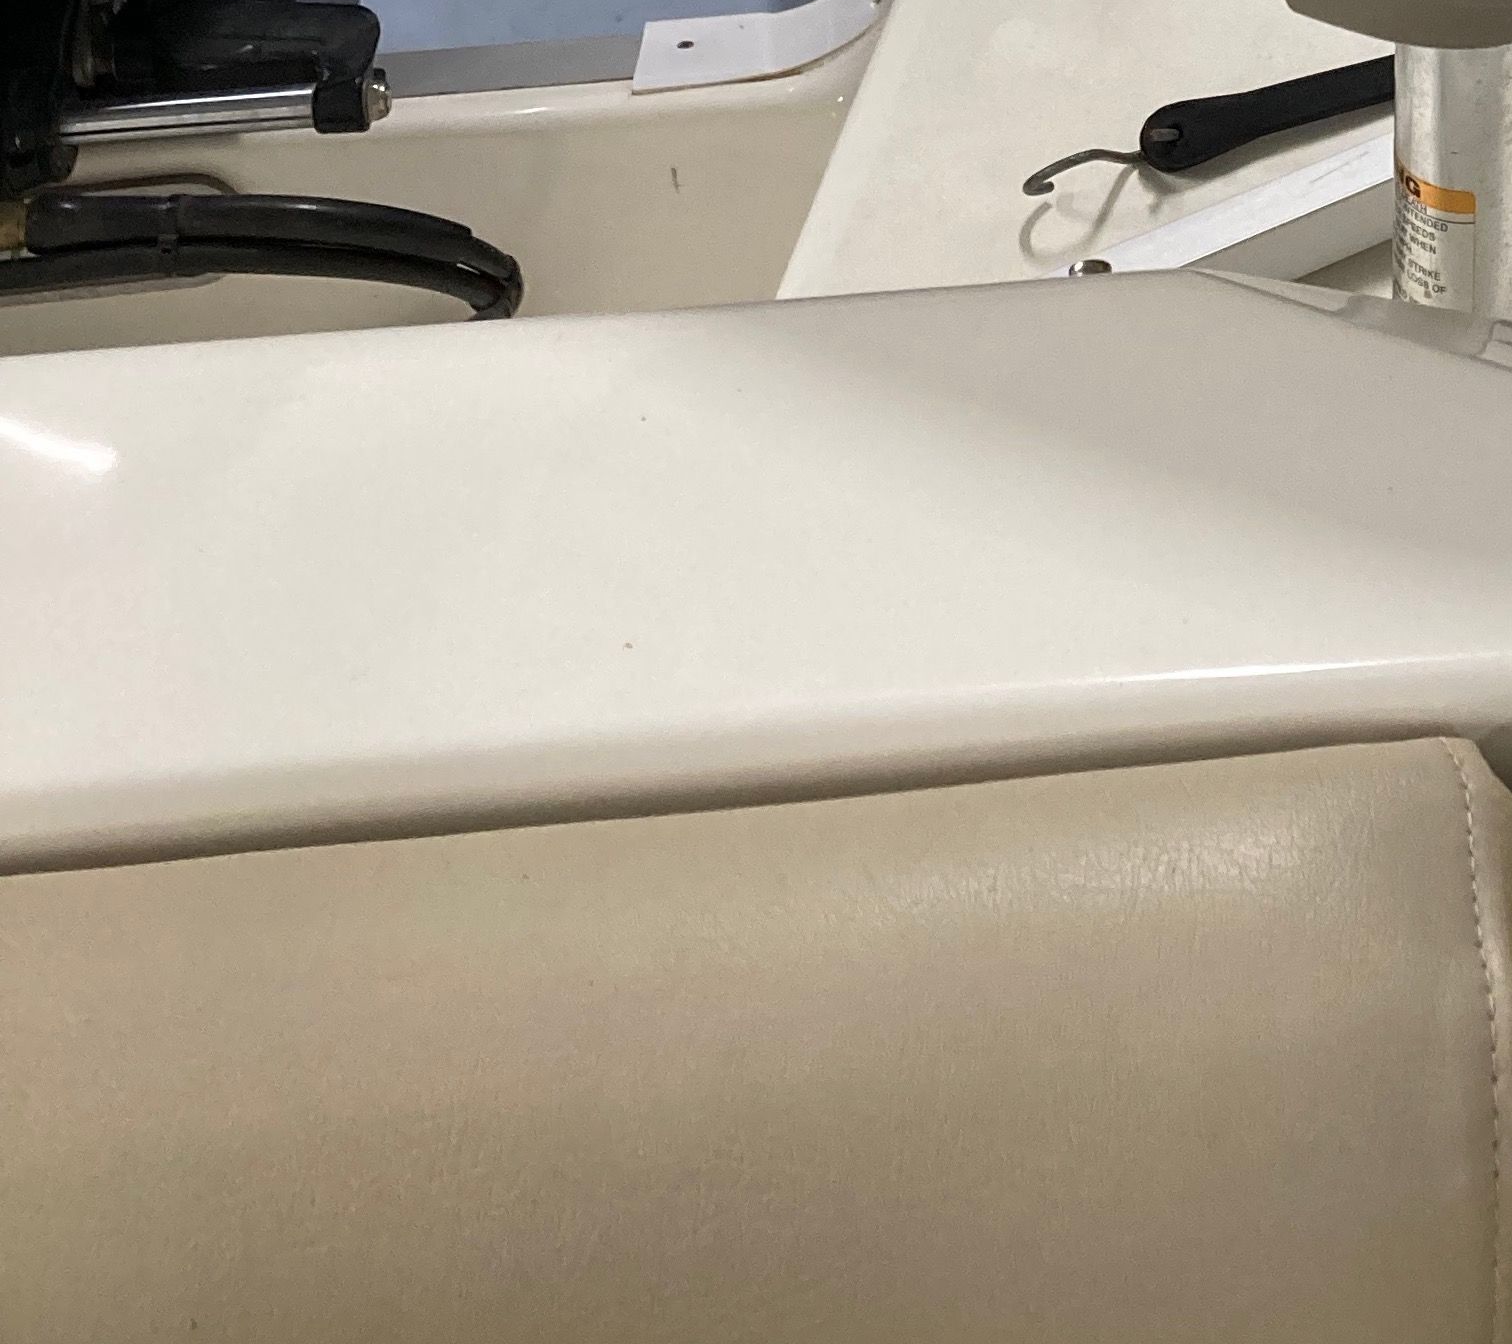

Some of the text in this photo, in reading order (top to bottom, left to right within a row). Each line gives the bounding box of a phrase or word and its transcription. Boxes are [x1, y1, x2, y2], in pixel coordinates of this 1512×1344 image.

[1409, 232, 1437, 256] WHEN
[1406, 269, 1430, 290] LOSS
[1431, 282, 1448, 295] OF
[1408, 257, 1442, 282] STRIKE
